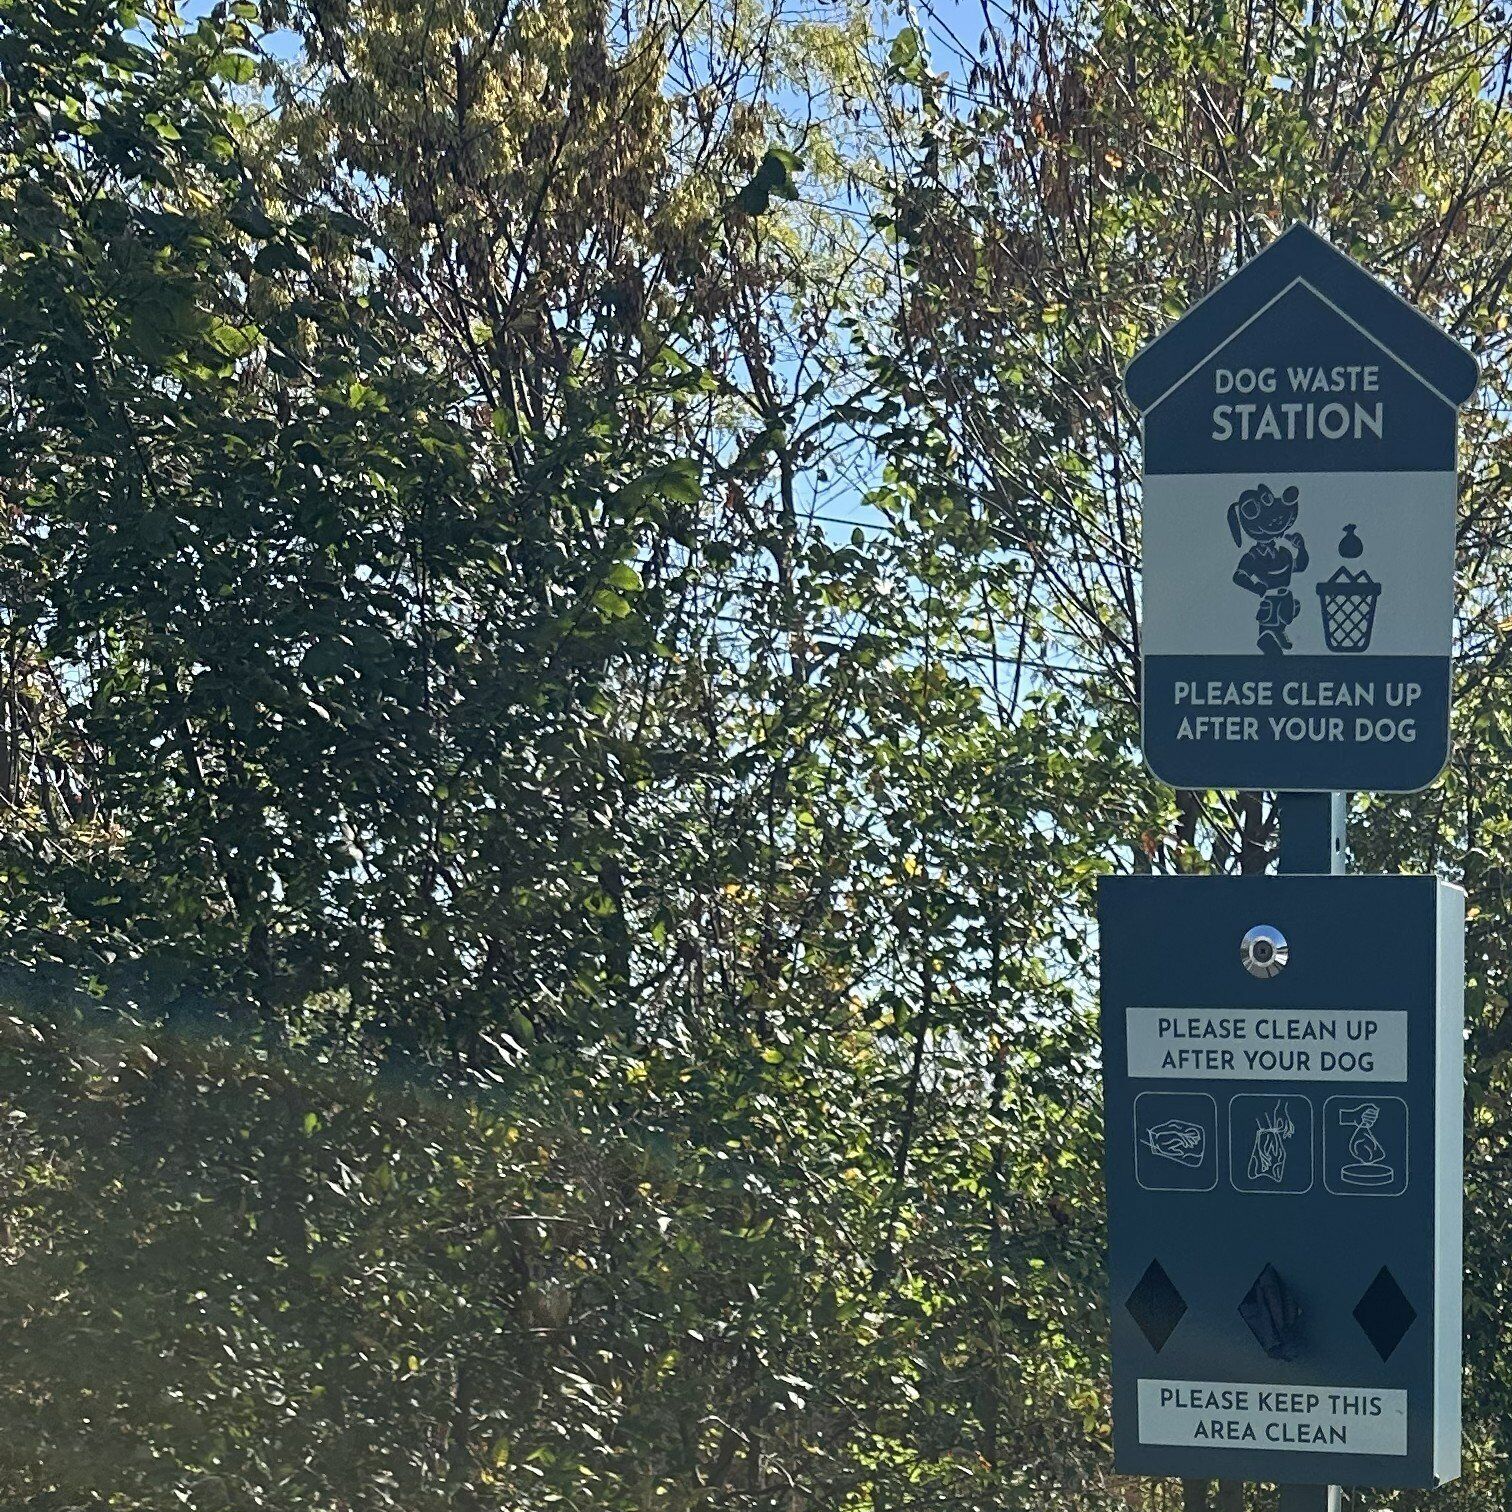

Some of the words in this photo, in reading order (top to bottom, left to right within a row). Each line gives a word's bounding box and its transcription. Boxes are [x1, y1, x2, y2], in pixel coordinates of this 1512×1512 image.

[1215, 368, 1277, 394] DOG
[1287, 366, 1380, 393] WASTE
[1211, 402, 1384, 441] STATION
[1174, 681, 1273, 706] PLEASE
[1281, 682, 1374, 707] CLEAN
[1386, 682, 1422, 708] UP
[1176, 717, 1259, 741] AFTER
[1268, 718, 1346, 742] YOUR
[1355, 718, 1417, 743] DOG
[1158, 1018, 1247, 1039] PLEASE
[1254, 1019, 1336, 1041] CLEAN
[1346, 1020, 1378, 1041] UP
[1161, 1050, 1235, 1071] AFTER
[1243, 1050, 1311, 1072] YOUR
[1320, 1052, 1375, 1073] DOG
[1160, 1388, 1249, 1411] PLEASE
[1258, 1392, 1320, 1414] KEEP
[1327, 1395, 1382, 1417] THIS
[1193, 1419, 1257, 1441] AREA
[1265, 1422, 1347, 1445] CLEAN
